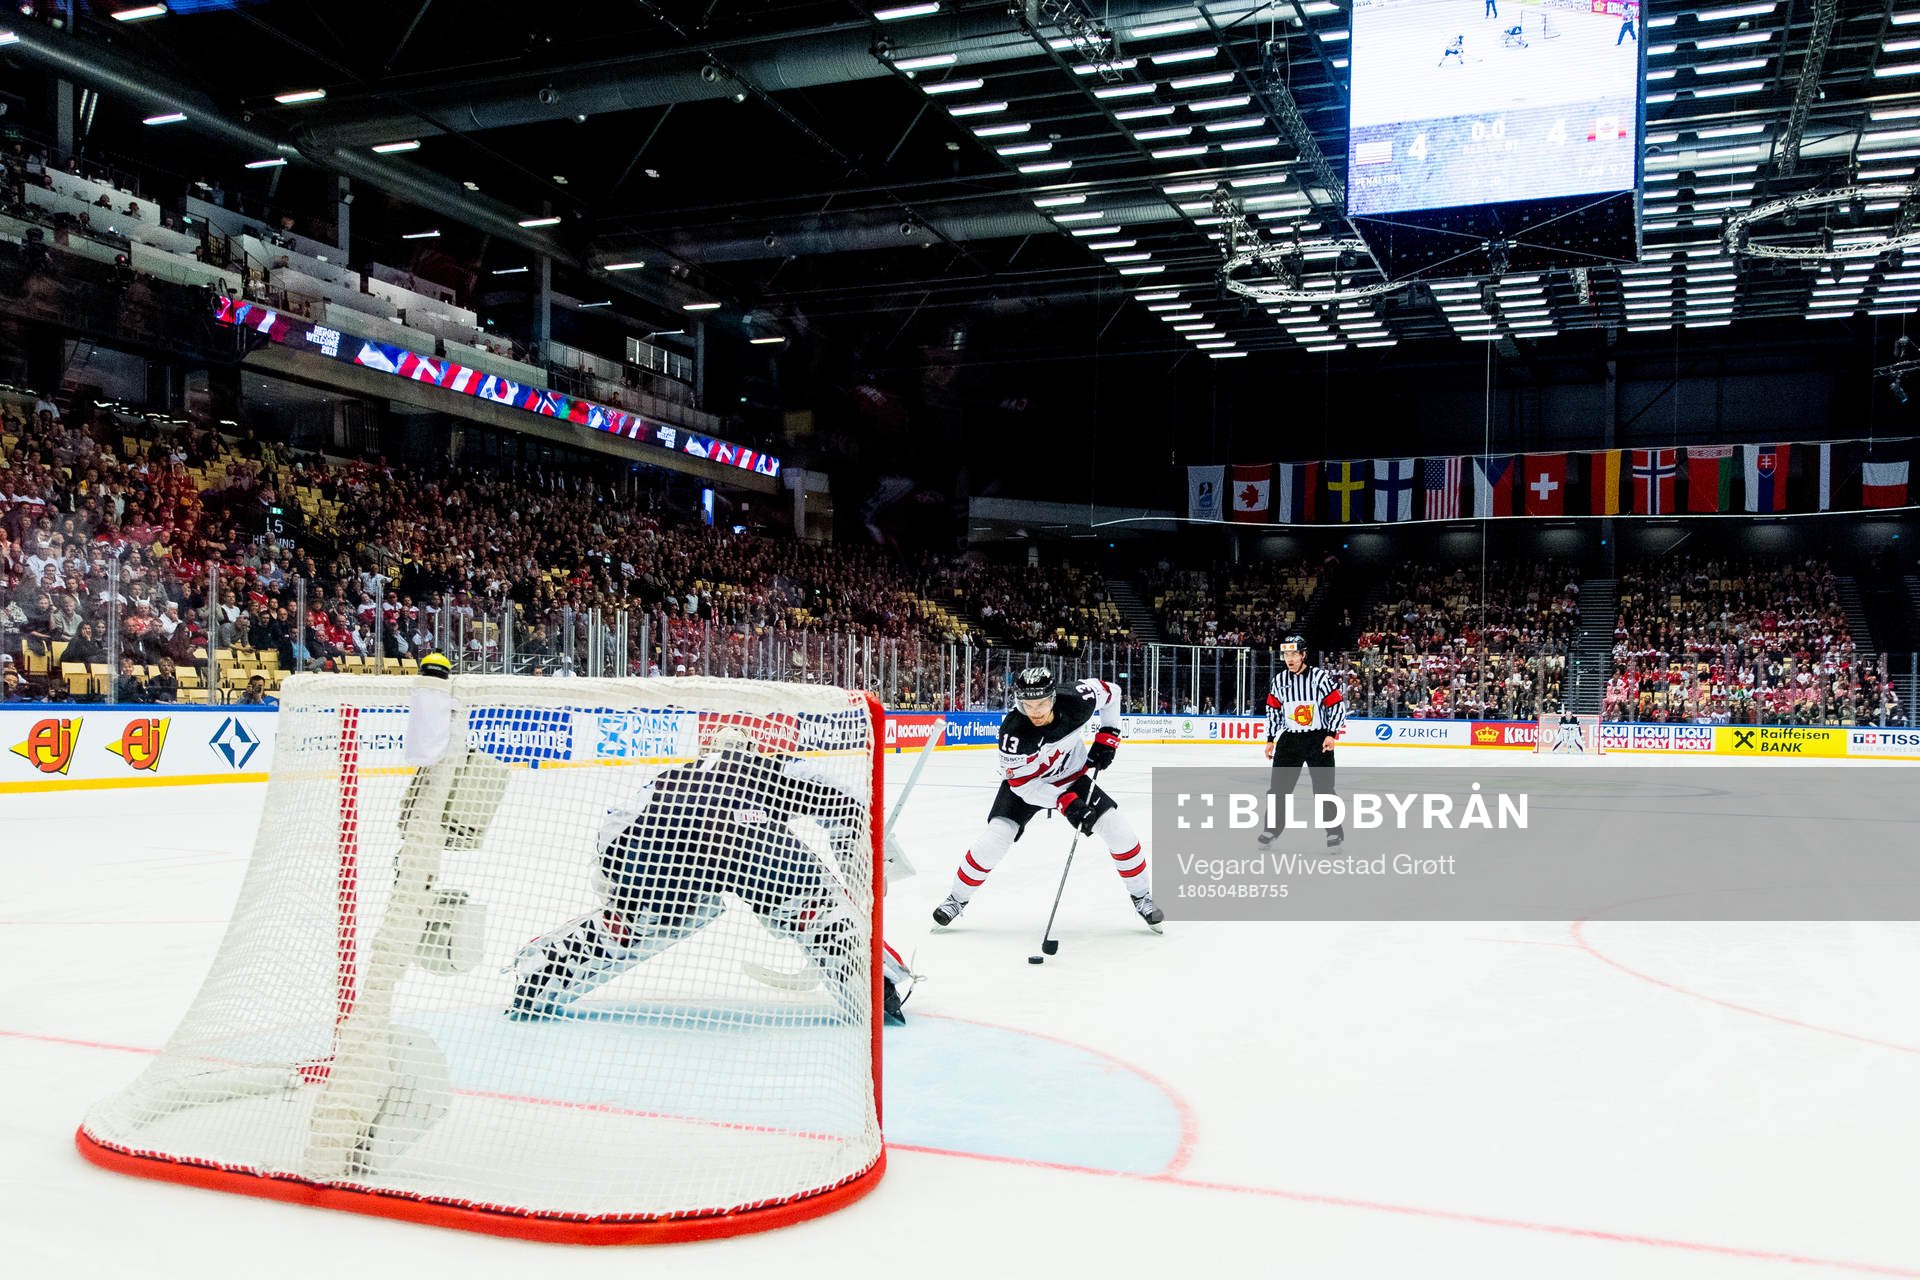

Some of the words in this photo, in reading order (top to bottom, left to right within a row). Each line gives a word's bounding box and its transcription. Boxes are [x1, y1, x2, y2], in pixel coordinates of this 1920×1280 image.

[1549, 118, 1567, 146] 4
[1408, 132, 1428, 161] 4
[631, 714, 680, 735] DANSK
[946, 721, 963, 740] City
[964, 721, 972, 737] of
[1221, 722, 1265, 739] IIHF
[1164, 727, 1177, 736] App
[1399, 727, 1448, 738] ZURICH
[1634, 727, 1669, 738] LIQUI
[1676, 728, 1711, 739] LIQUI
[1760, 728, 1830, 740] Raiffeisen
[630, 736, 678, 757] METAL
[1001, 733, 1020, 753] 13
[1634, 738, 1669, 749] MOLY
[1676, 738, 1711, 749] MOLY
[1760, 742, 1803, 753] BANK
